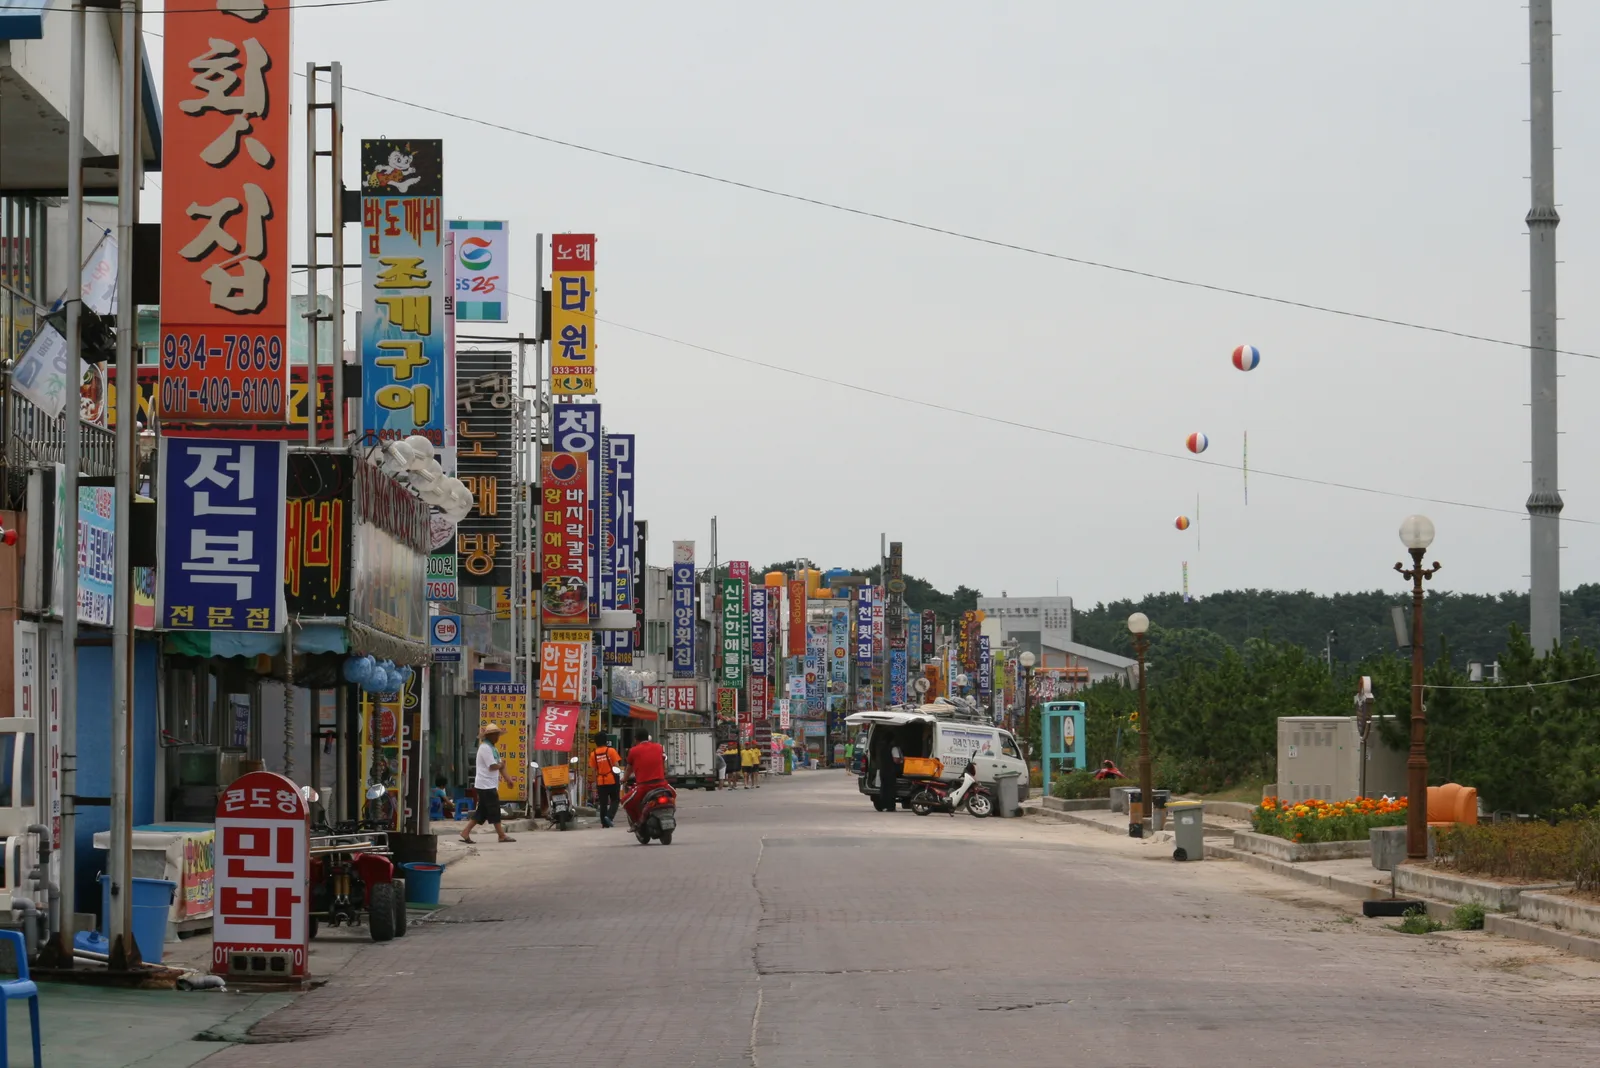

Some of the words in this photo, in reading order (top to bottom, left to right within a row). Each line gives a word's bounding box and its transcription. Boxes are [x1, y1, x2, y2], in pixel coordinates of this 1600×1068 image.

[177, 0, 275, 314] 횟집
[557, 243, 591, 261] 노래
[163, 334, 281, 371] 934-7869
[373, 256, 432, 426] 조개구이
[559, 276, 590, 360] 타원
[162, 376, 281, 414] 011-409-8100
[553, 366, 592, 375] 933-3112
[181, 446, 260, 601] 전복
[565, 488, 585, 591] 바지락칼국수
[437, 624, 455, 634] 담배
[675, 568, 694, 666] 오대양횟집
[724, 585, 740, 679] 신선한해물탕
[858, 588, 872, 658] 대천횟집
[542, 645, 560, 698] 한식
[562, 647, 579, 700] 분식
[224, 788, 297, 813] 콘도형
[220, 826, 301, 939] 민박
